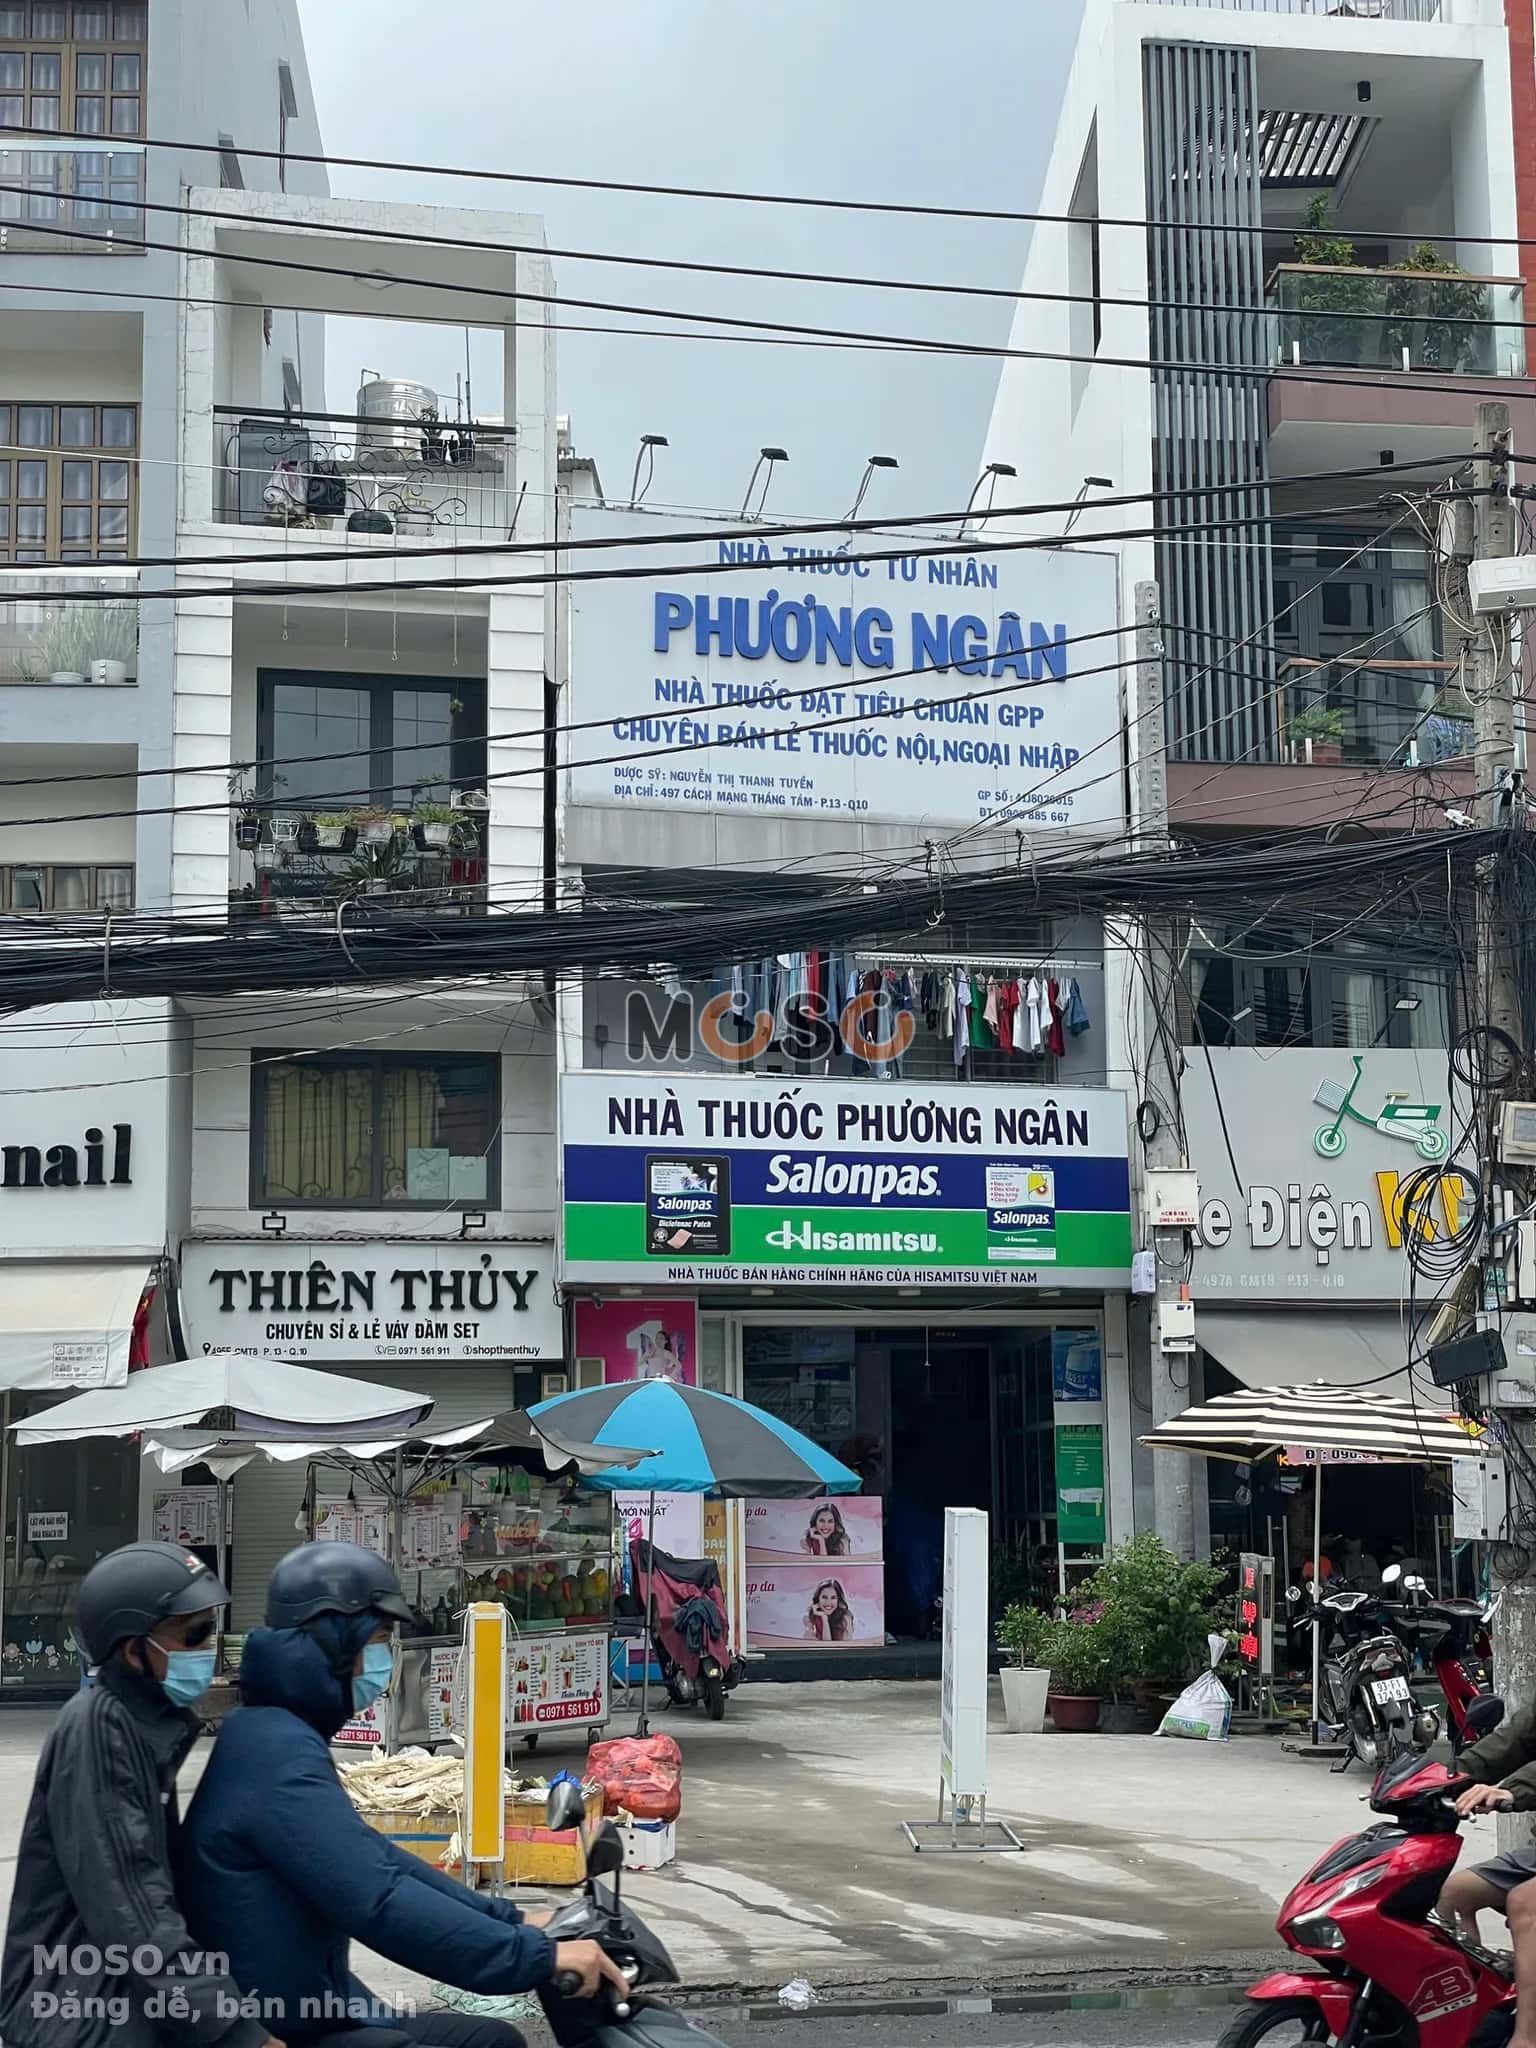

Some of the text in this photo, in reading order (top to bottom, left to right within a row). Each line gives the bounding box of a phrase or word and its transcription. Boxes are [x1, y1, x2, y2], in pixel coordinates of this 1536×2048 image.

[719, 538, 771, 569] NHÀ
[783, 540, 870, 577] THUỐC
[929, 557, 998, 588] NHÂN
[654, 589, 1067, 682] PHƯƠNG NGÂN
[655, 676, 704, 704] NHÀ
[712, 679, 792, 710] THUỐC
[801, 692, 846, 718] ĐẠT
[855, 690, 904, 719] TIÊU
[998, 704, 1044, 728] GPP
[613, 717, 709, 744] CHUYÊN
[717, 720, 765, 750] BÁN
[774, 721, 800, 752] LẺ
[809, 728, 887, 757] THUỐC
[1020, 742, 1079, 773] NHẬP
[670, 768, 712, 784] NGUYỄN
[717, 774, 735, 788] THỊ
[739, 775, 775, 788] THANH
[614, 784, 632, 798] ĐỊA
[683, 787, 712, 801] CÁCH
[717, 792, 748, 805] MẠNG
[751, 791, 786, 806] THÁNG
[978, 790, 991, 801] GP
[1051, 811, 1070, 823] 667
[607, 1088, 1088, 1147] NHÀ THUỐC PHƯƠNG NGÂN
[1, 1124, 133, 1188] nail
[766, 1154, 939, 1203] Salonpas
[657, 1197, 712, 1212] Salonpas
[993, 1210, 1050, 1227] Salonpas
[1247, 1184, 1372, 1265] Điện
[766, 1220, 937, 1253] Hisamitsu
[210, 1254, 538, 1312] THIÊN THỦY
[668, 1266, 694, 1280] NHÀ
[698, 1266, 738, 1280] THUỐC
[742, 1267, 767, 1280] BÁN
[771, 1267, 804, 1281] HÀNG
[808, 1268, 846, 1281] CHÍNH
[886, 1268, 911, 1282] CỦA
[914, 1271, 979, 1283] HISAMITSU
[982, 1269, 1007, 1284] VIỆT
[1011, 1271, 1037, 1283] NAM
[266, 1318, 479, 1340] CHUYÊN SỈ & LẺ VÁY ĐẦM SET
[398, 1346, 450, 1355] 0971 561 911
[546, 1701, 598, 1717] 0971 561 911
